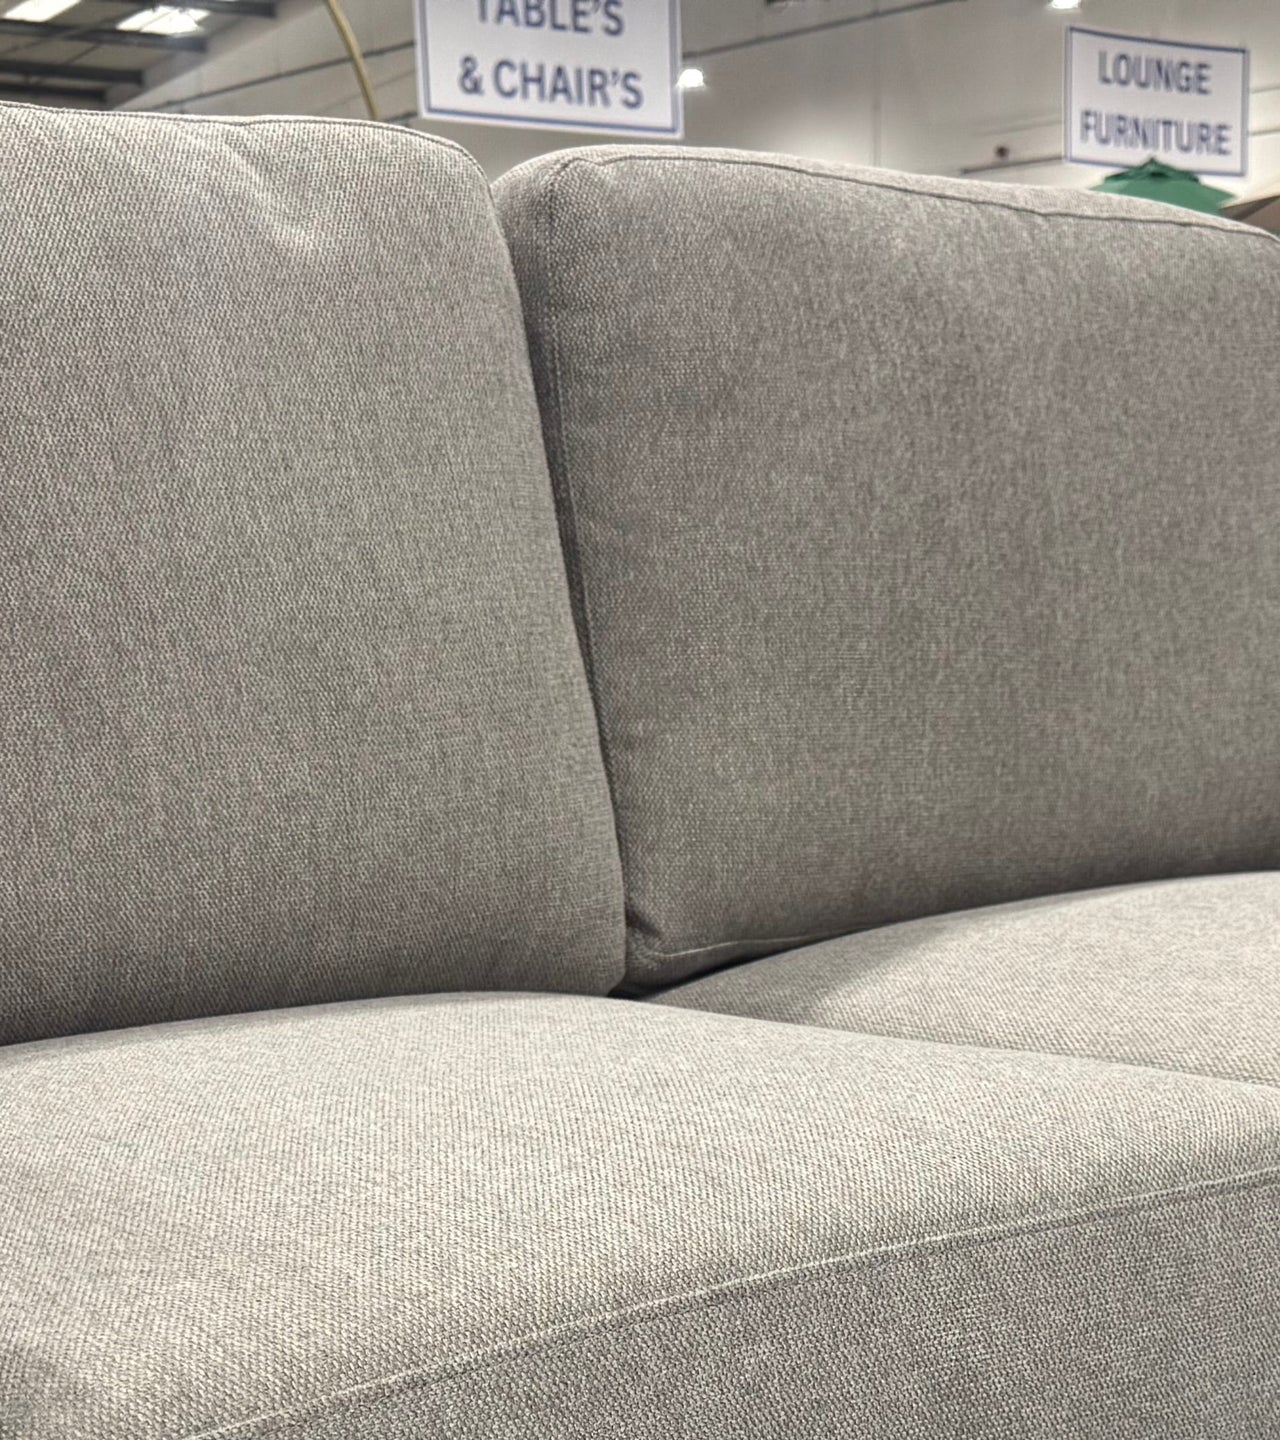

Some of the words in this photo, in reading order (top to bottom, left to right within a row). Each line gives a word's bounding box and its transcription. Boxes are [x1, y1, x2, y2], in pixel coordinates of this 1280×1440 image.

[459, 54, 483, 96] &
[493, 59, 643, 109] CHAIR'S
[1098, 51, 1211, 94] LOUNGE
[1081, 109, 1231, 155] FURNITURE
